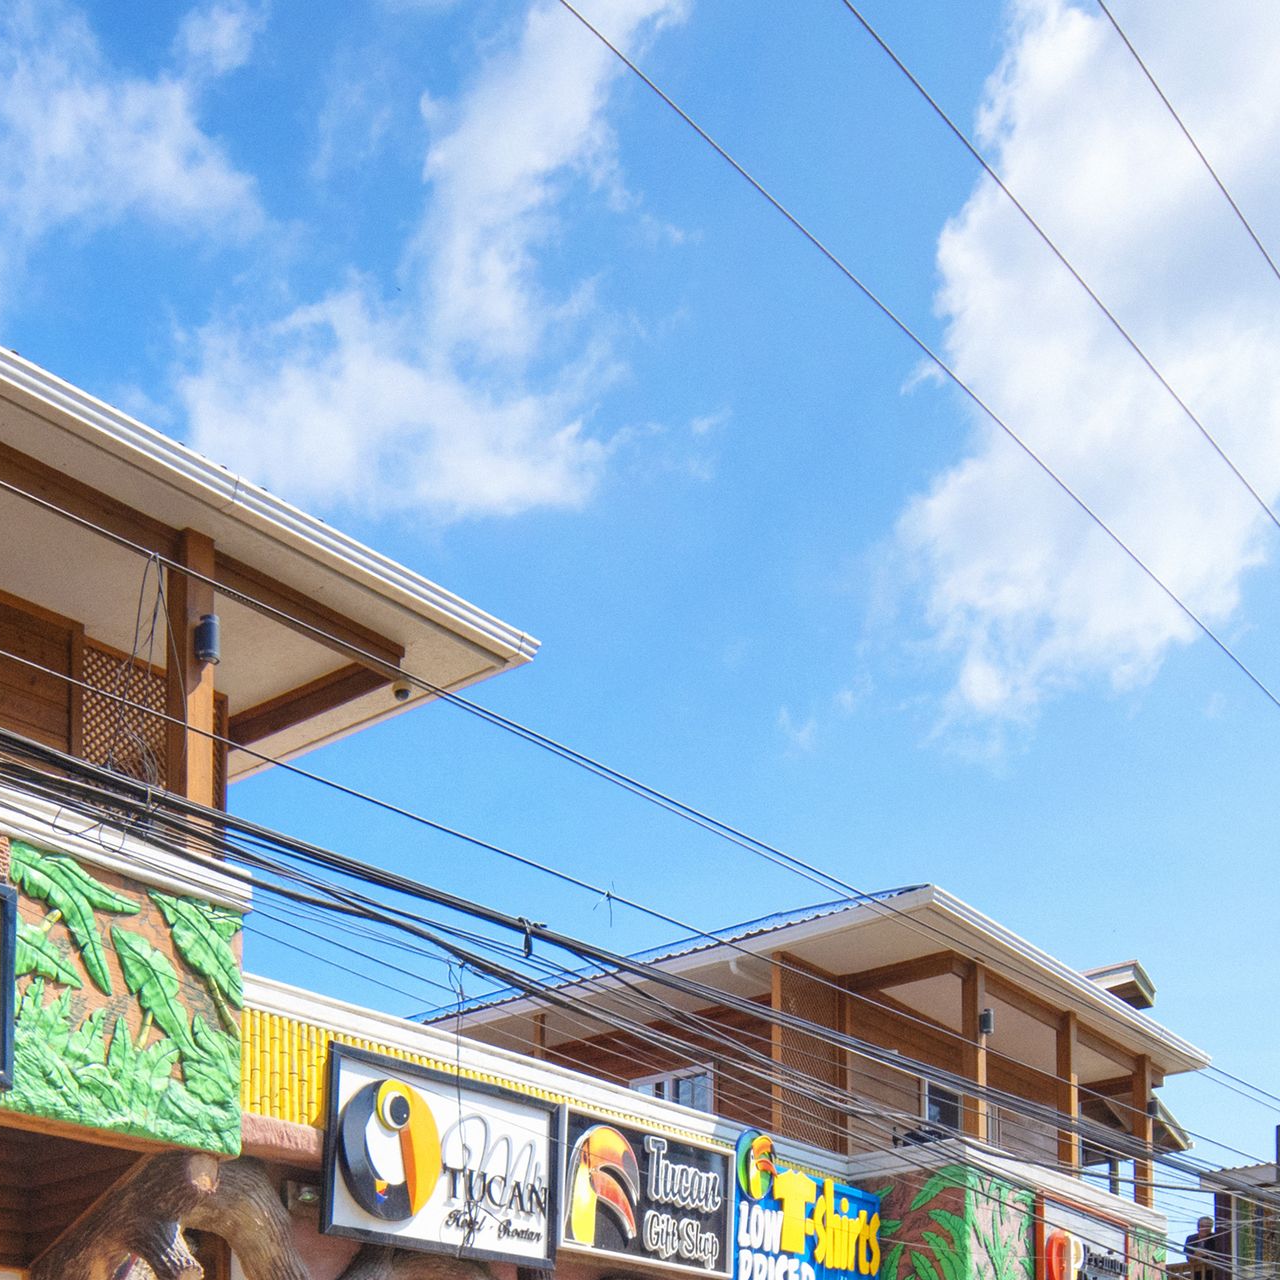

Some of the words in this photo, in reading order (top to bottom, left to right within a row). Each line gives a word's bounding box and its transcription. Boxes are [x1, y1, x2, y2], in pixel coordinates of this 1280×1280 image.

[442, 1163, 550, 1219] TUCAN
[646, 1136, 721, 1211] Tucan
[497, 1219, 543, 1242] Roatan
[646, 1211, 678, 1259] Gift
[678, 1218, 719, 1270] Shop
[738, 1201, 784, 1254] LOW
